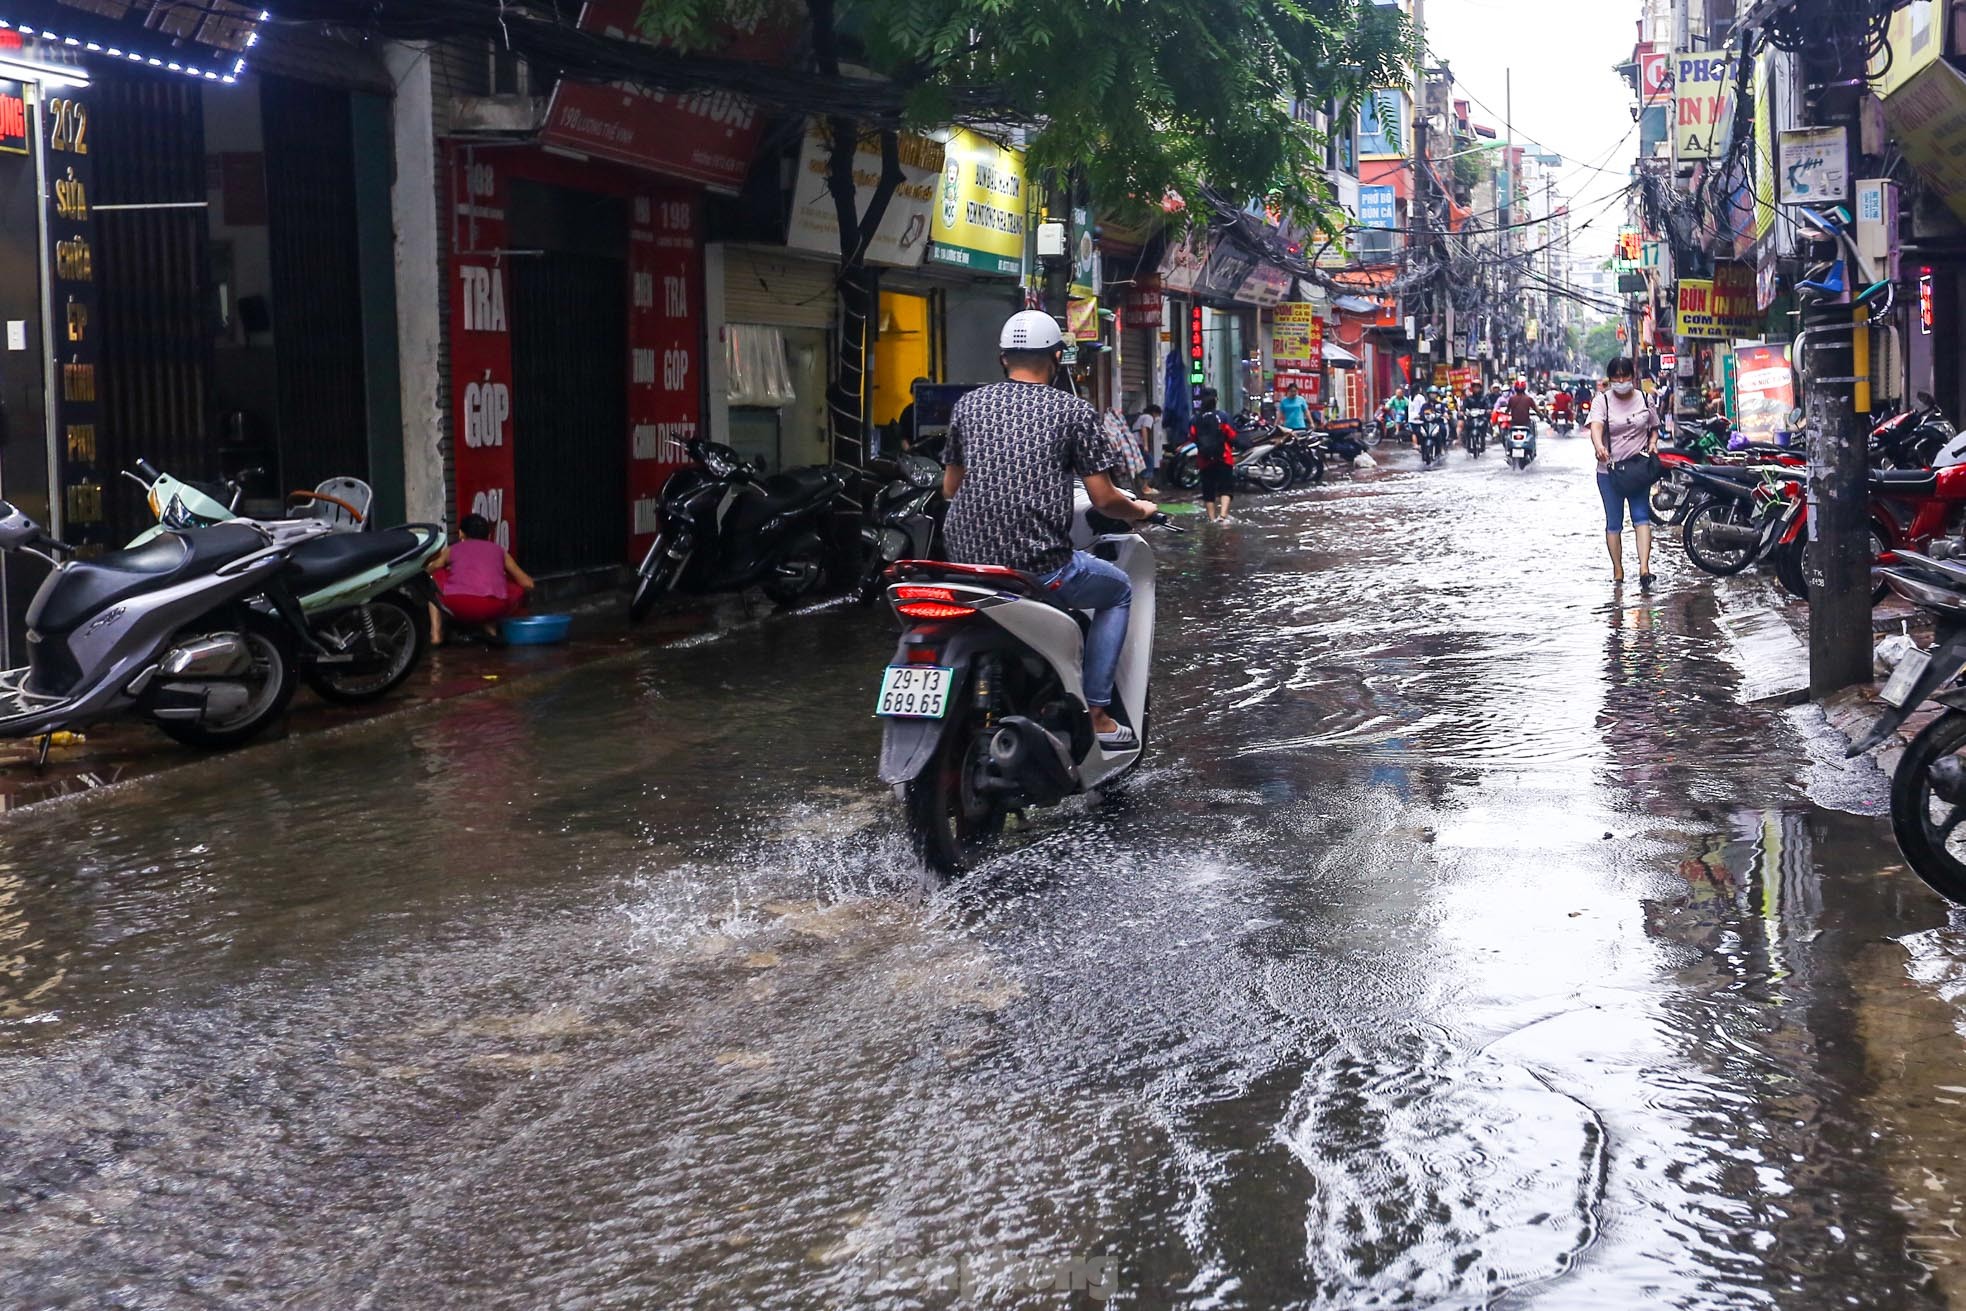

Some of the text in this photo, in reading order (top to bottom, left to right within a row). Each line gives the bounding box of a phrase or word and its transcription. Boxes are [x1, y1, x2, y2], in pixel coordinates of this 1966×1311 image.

[1677, 96, 1703, 126] IN
[50, 97, 88, 155] 202
[55, 166, 88, 221] SỬA
[1361, 189, 1379, 205] PHỞ
[1380, 205, 1393, 218] CÁ
[1641, 243, 1659, 266] 17
[459, 246, 507, 332] TRẢ
[664, 262, 688, 318] TRẢ
[1680, 284, 1707, 312] BÚN
[1714, 295, 1729, 316] IN
[664, 340, 689, 393] GÓP
[463, 369, 510, 449] GÓP
[893, 670, 941, 691] 29-Y3
[882, 691, 942, 714] 689.65
